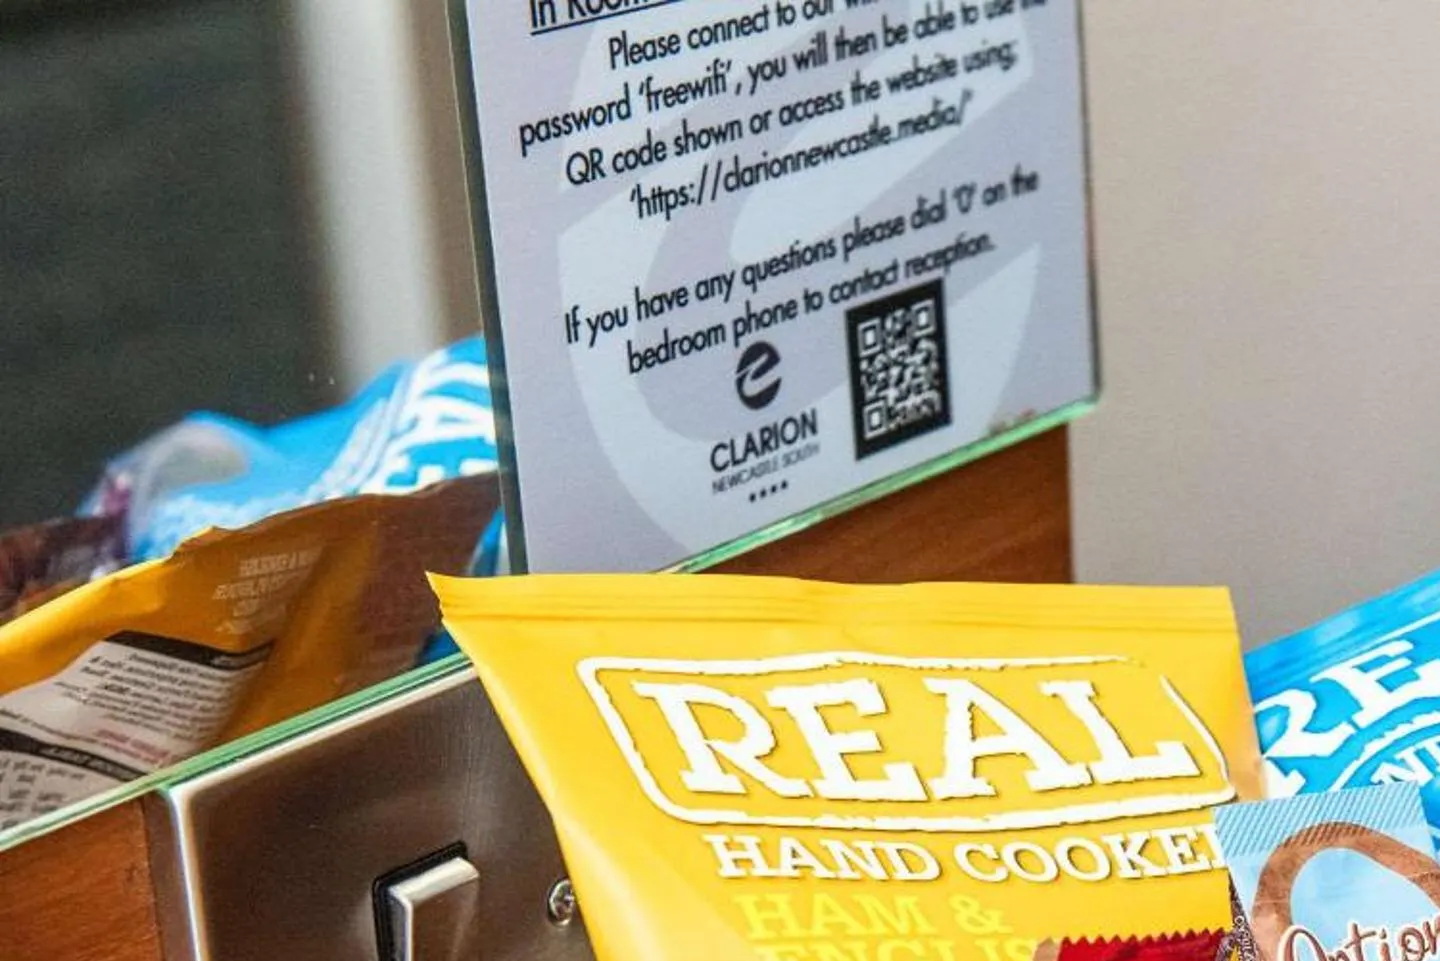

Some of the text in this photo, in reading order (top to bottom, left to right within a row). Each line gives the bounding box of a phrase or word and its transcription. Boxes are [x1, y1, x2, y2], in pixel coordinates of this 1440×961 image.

[519, 82, 631, 157] password
[748, 54, 786, 95] you
[793, 30, 828, 70] will
[835, 27, 877, 61] then
[882, 14, 908, 48] be
[914, 1, 956, 39] able
[961, 2, 979, 27] to
[609, 0, 834, 70] Please connect to our
[565, 148, 606, 186] QR
[612, 129, 667, 174] code
[674, 119, 743, 157] shown
[749, 111, 772, 135] or
[779, 90, 844, 126] access
[851, 70, 880, 104] the
[886, 54, 957, 93] website
[564, 305, 581, 344] If
[586, 306, 628, 347] you
[634, 286, 689, 321] have
[695, 270, 735, 303] any
[741, 240, 836, 294] questions
[842, 215, 905, 263] please
[910, 189, 946, 230] dial
[982, 181, 1007, 206] on
[1010, 163, 1039, 197] the
[627, 232, 996, 375] bedroom phone to contact reception.
[710, 408, 818, 472] CLARION
[712, 442, 820, 495] NEWCASTLE SOUTH
[633, 677, 1200, 802] REAL
[704, 833, 940, 883] HAND
[734, 892, 1014, 940] HAM &
